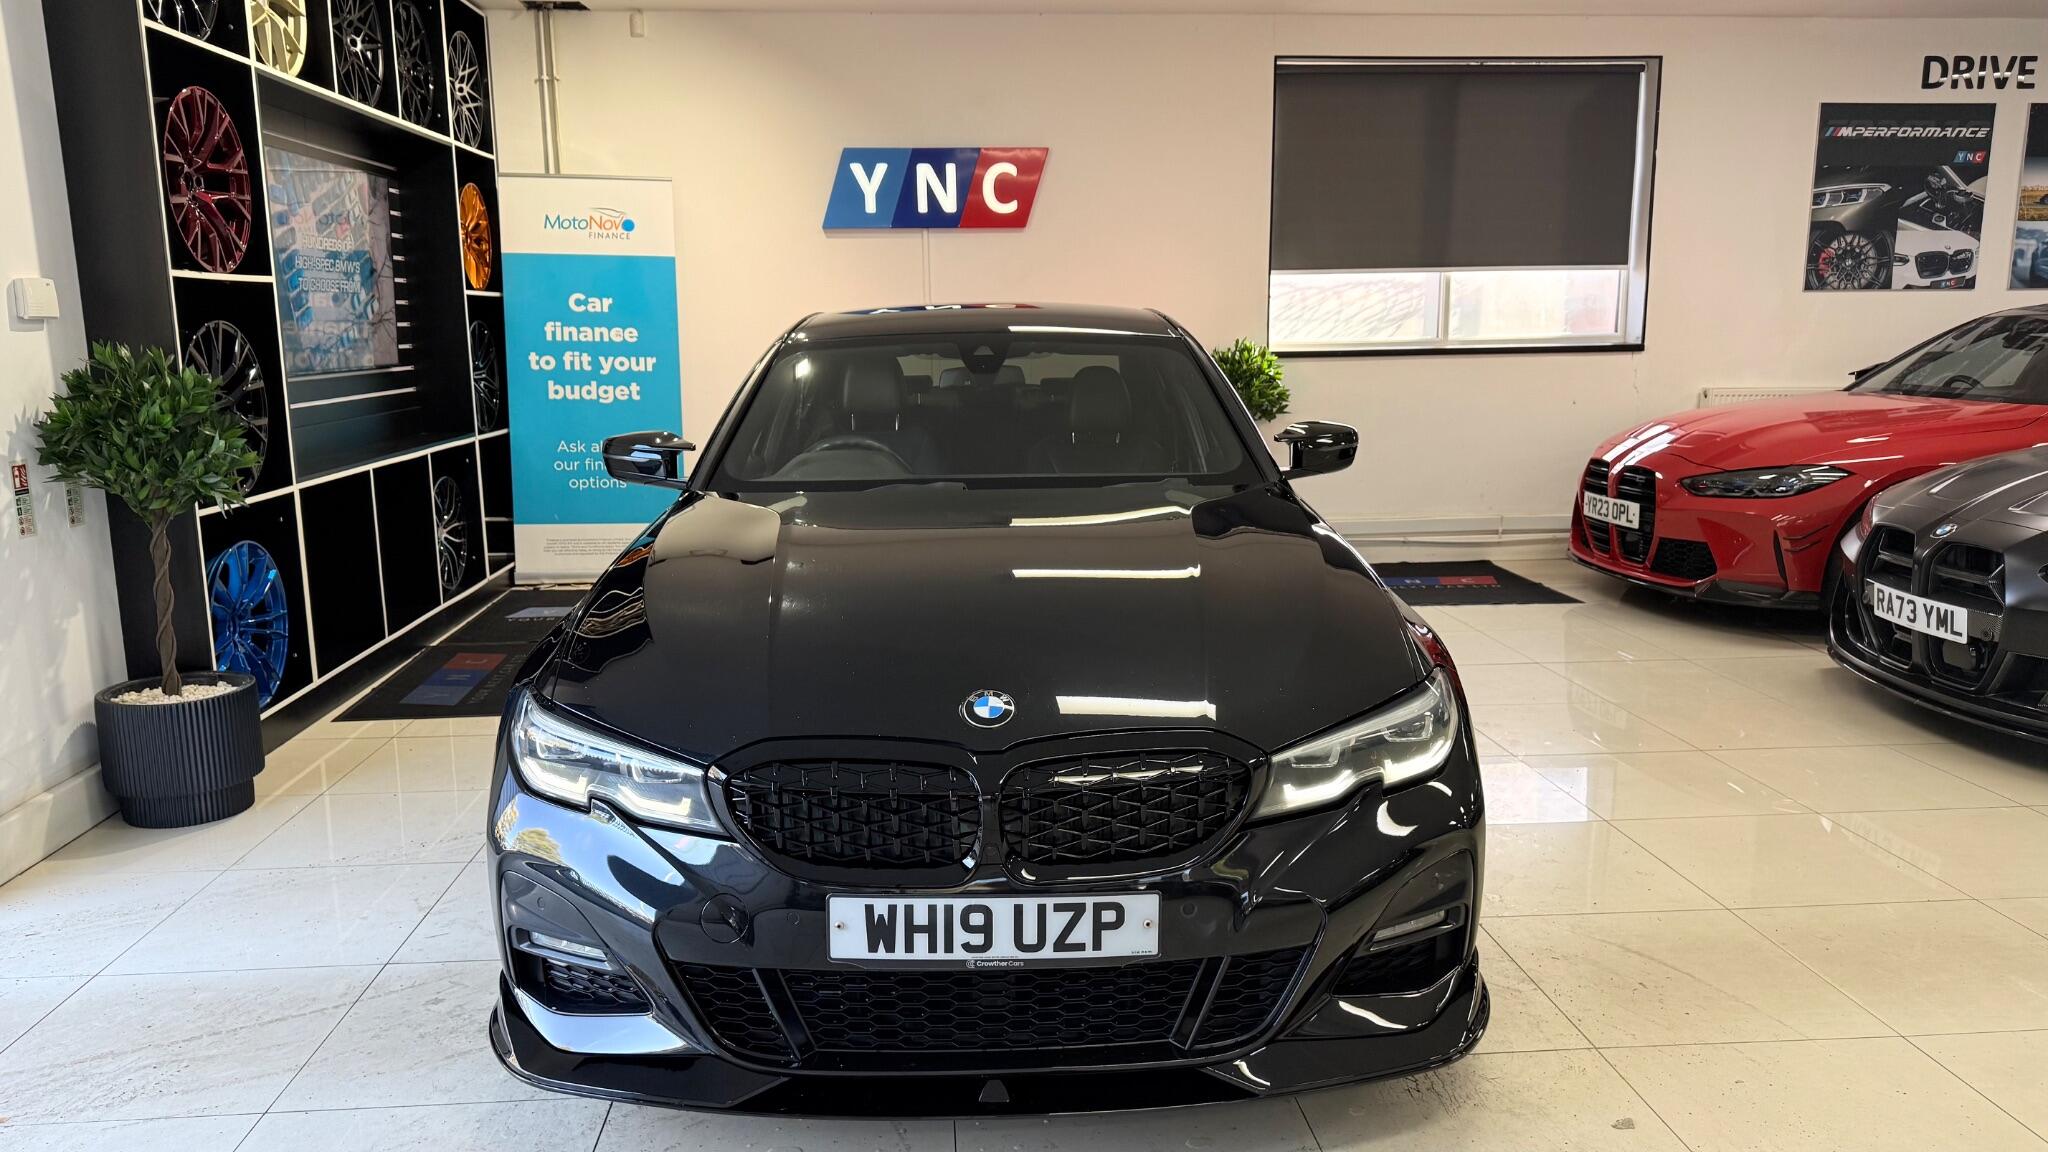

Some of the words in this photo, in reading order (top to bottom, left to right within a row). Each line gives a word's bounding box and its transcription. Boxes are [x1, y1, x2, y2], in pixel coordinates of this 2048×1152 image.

[1921, 56, 2038, 89] DRIVE
[850, 162, 1018, 214] YNC
[588, 232, 631, 240] FINANCE
[298, 277, 309, 291] TO
[568, 293, 613, 312] Car
[544, 321, 639, 342] finance
[528, 352, 556, 371] to
[562, 351, 592, 371] fit
[598, 356, 656, 375] your
[548, 380, 640, 404] budget
[557, 440, 586, 453] Ask
[554, 460, 580, 471] our
[568, 476, 627, 491] options
[1587, 495, 1610, 518] YR23
[1876, 587, 1917, 624] RA73
[1922, 602, 1963, 638] YML
[864, 903, 994, 954] WH19
[1013, 901, 1126, 953] UZP
